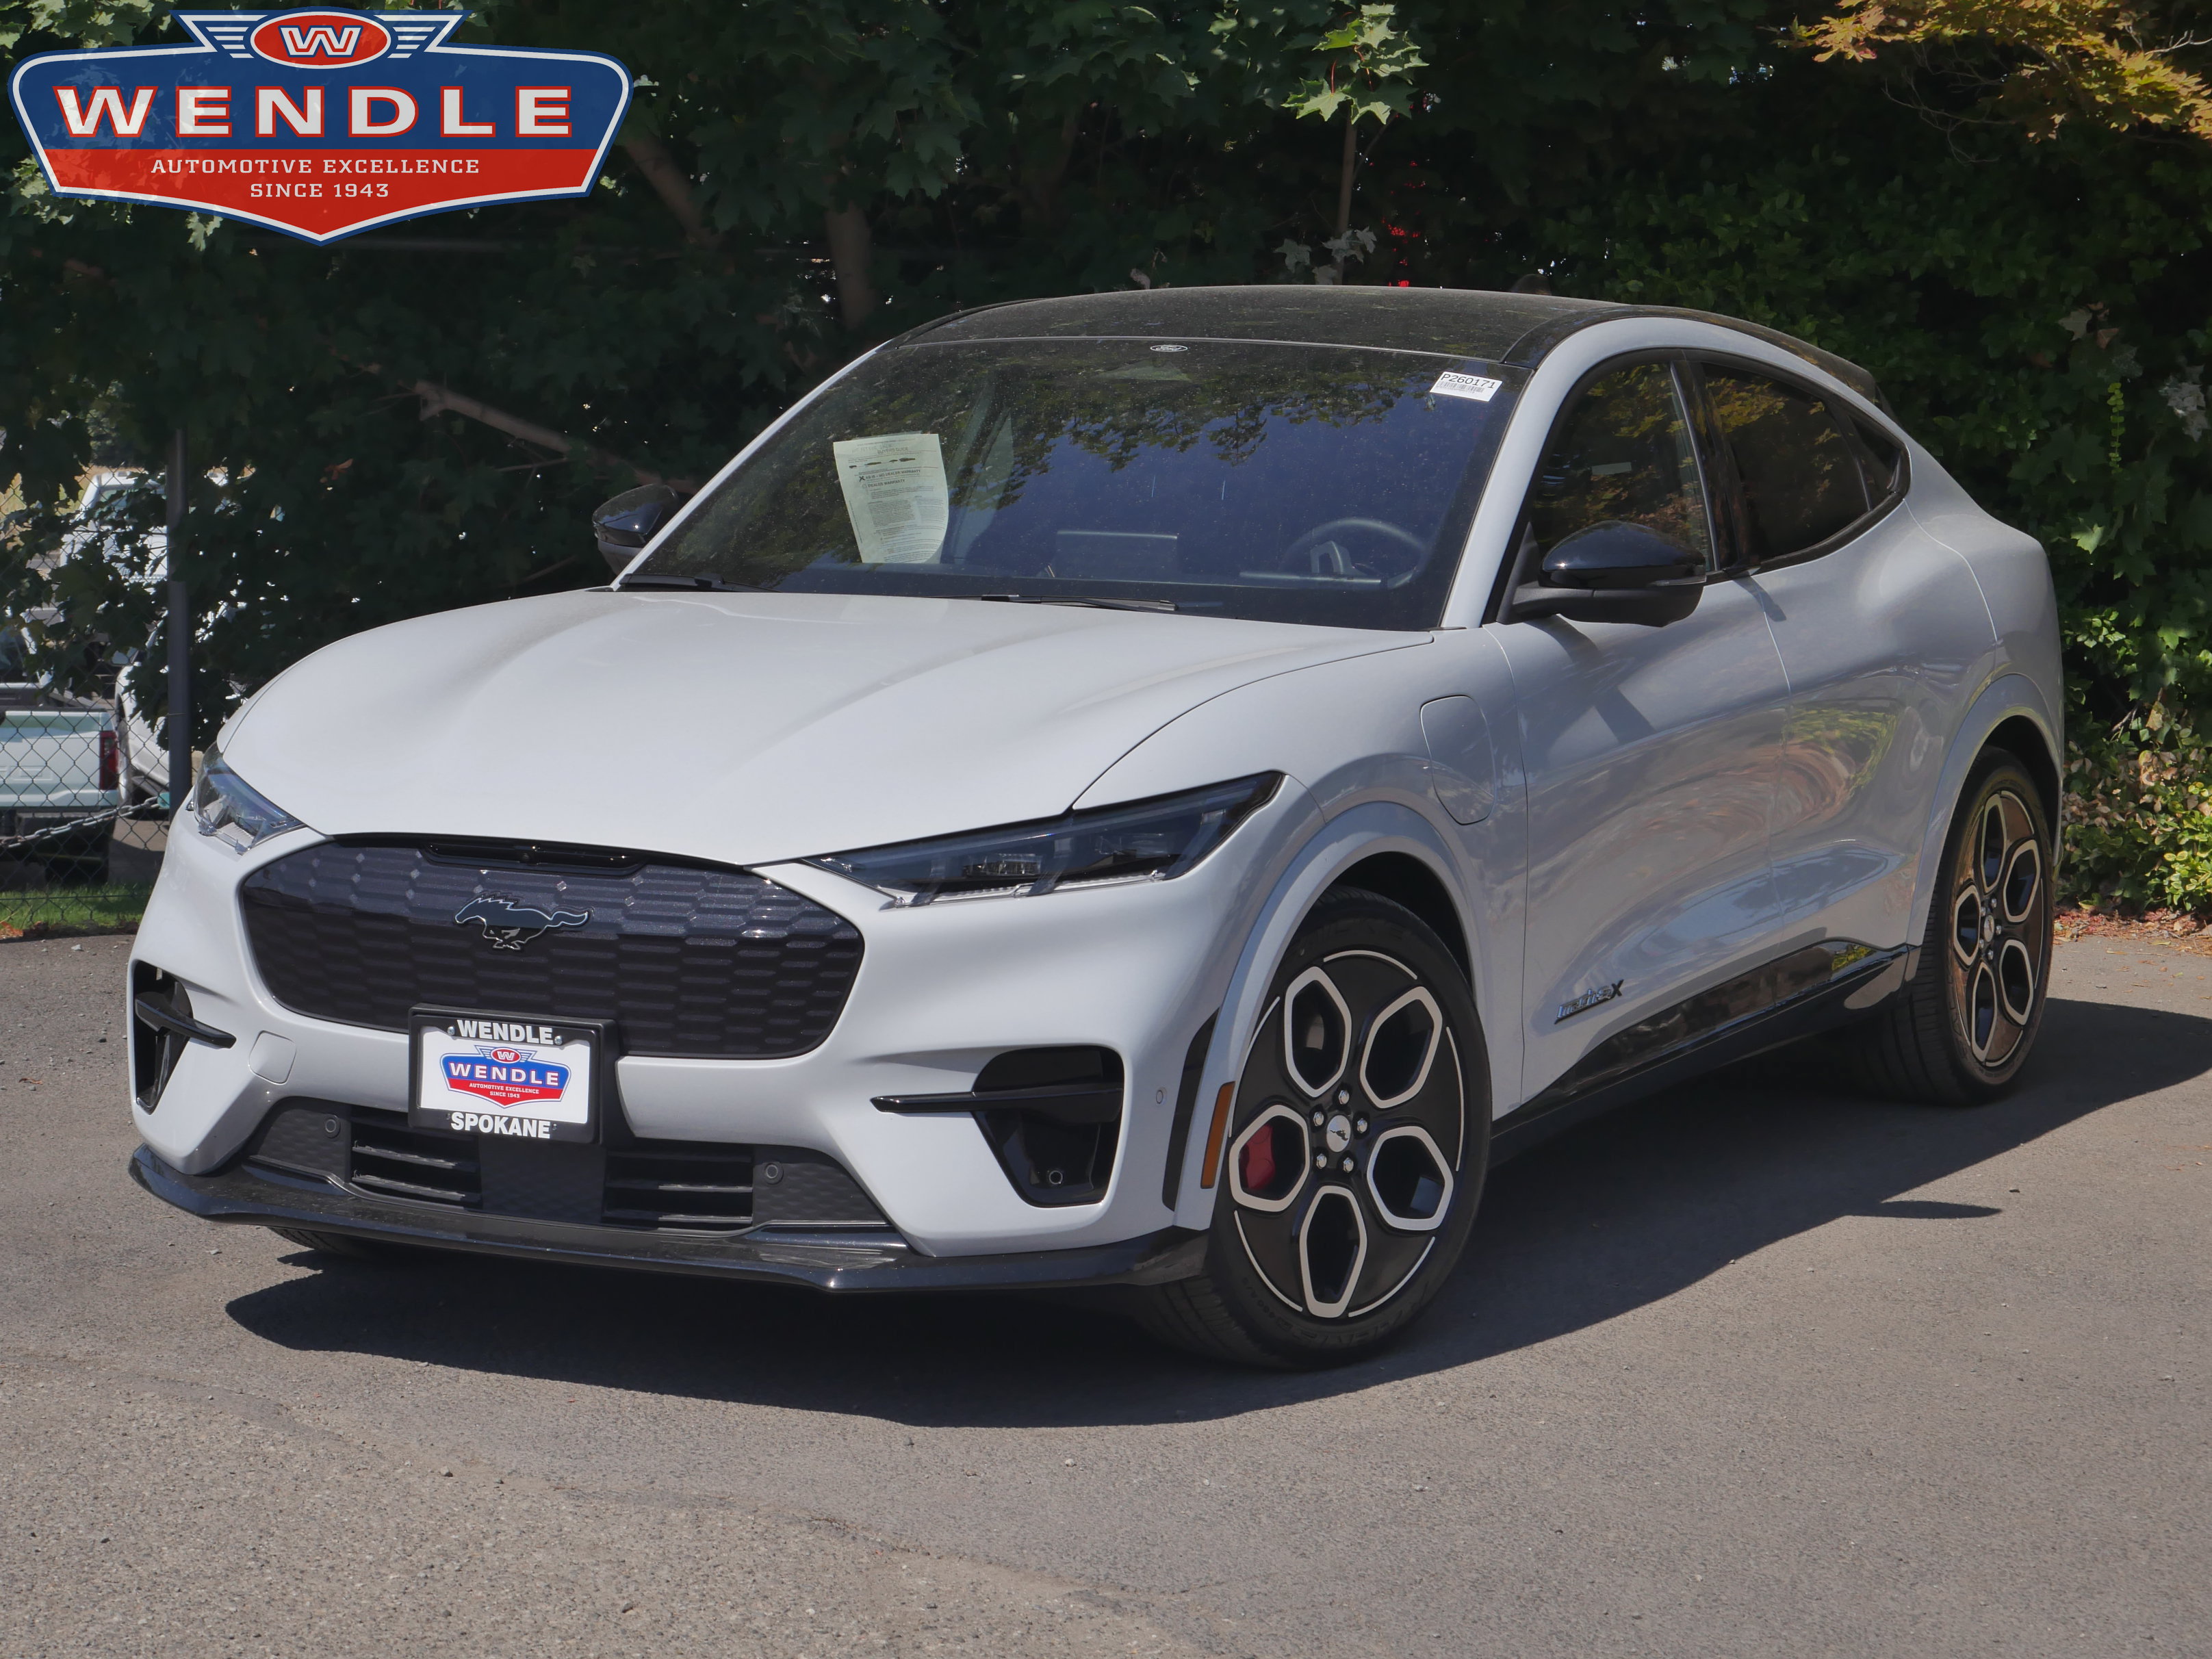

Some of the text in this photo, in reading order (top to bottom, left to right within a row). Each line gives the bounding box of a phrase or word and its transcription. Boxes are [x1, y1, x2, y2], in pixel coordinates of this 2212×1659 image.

[1441, 374, 1495, 389] P260171
[456, 1019, 554, 1045] WENDLE
[448, 1062, 559, 1086] WENDLE
[469, 1083, 539, 1094] AUTOMOTIVE EXCELLENCE
[451, 1111, 550, 1139] SPOKANE
